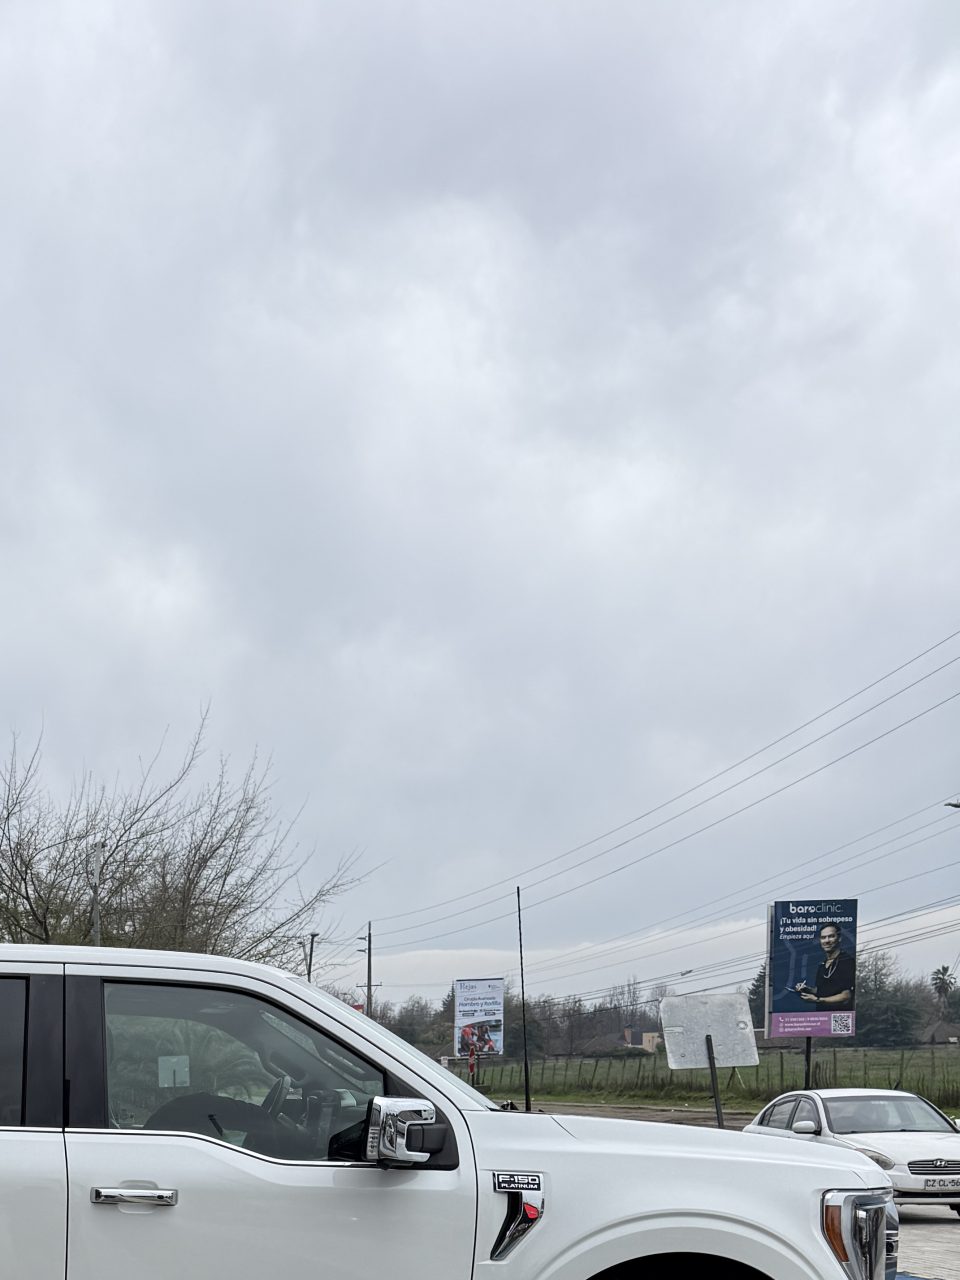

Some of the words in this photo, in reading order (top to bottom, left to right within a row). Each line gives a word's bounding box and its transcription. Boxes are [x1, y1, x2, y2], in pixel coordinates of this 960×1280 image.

[789, 902, 842, 914] baroclinic
[780, 917, 791, 925] ¡Tu
[818, 916, 853, 924] sobrepeso
[498, 1175, 539, 1183] F-150
